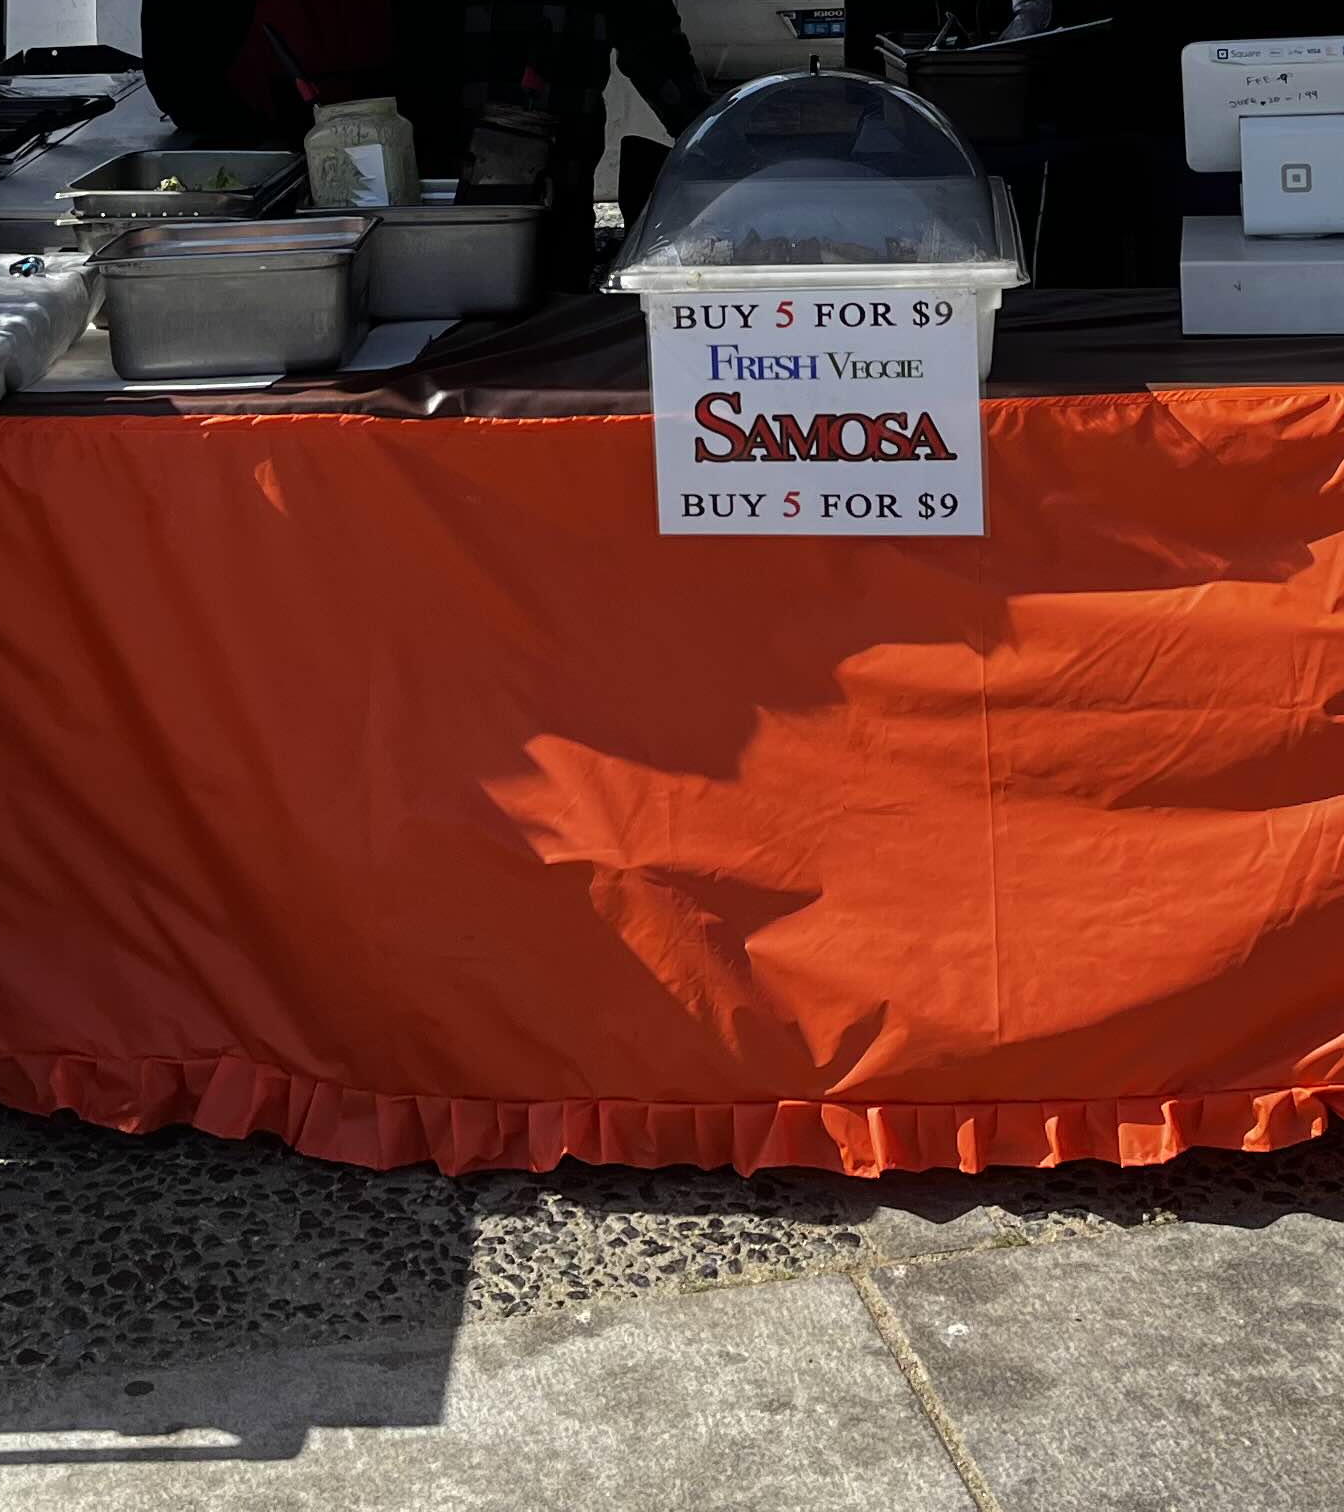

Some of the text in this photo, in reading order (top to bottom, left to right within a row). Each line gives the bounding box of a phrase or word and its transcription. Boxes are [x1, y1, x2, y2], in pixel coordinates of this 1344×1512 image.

[1231, 49, 1261, 58] Square
[672, 300, 954, 330] BUY 5 FOR $9
[705, 344, 923, 381] FRESH VEGGIE
[694, 391, 958, 463] SAMOSA
[681, 491, 959, 520] BUY 5 FOR $9
